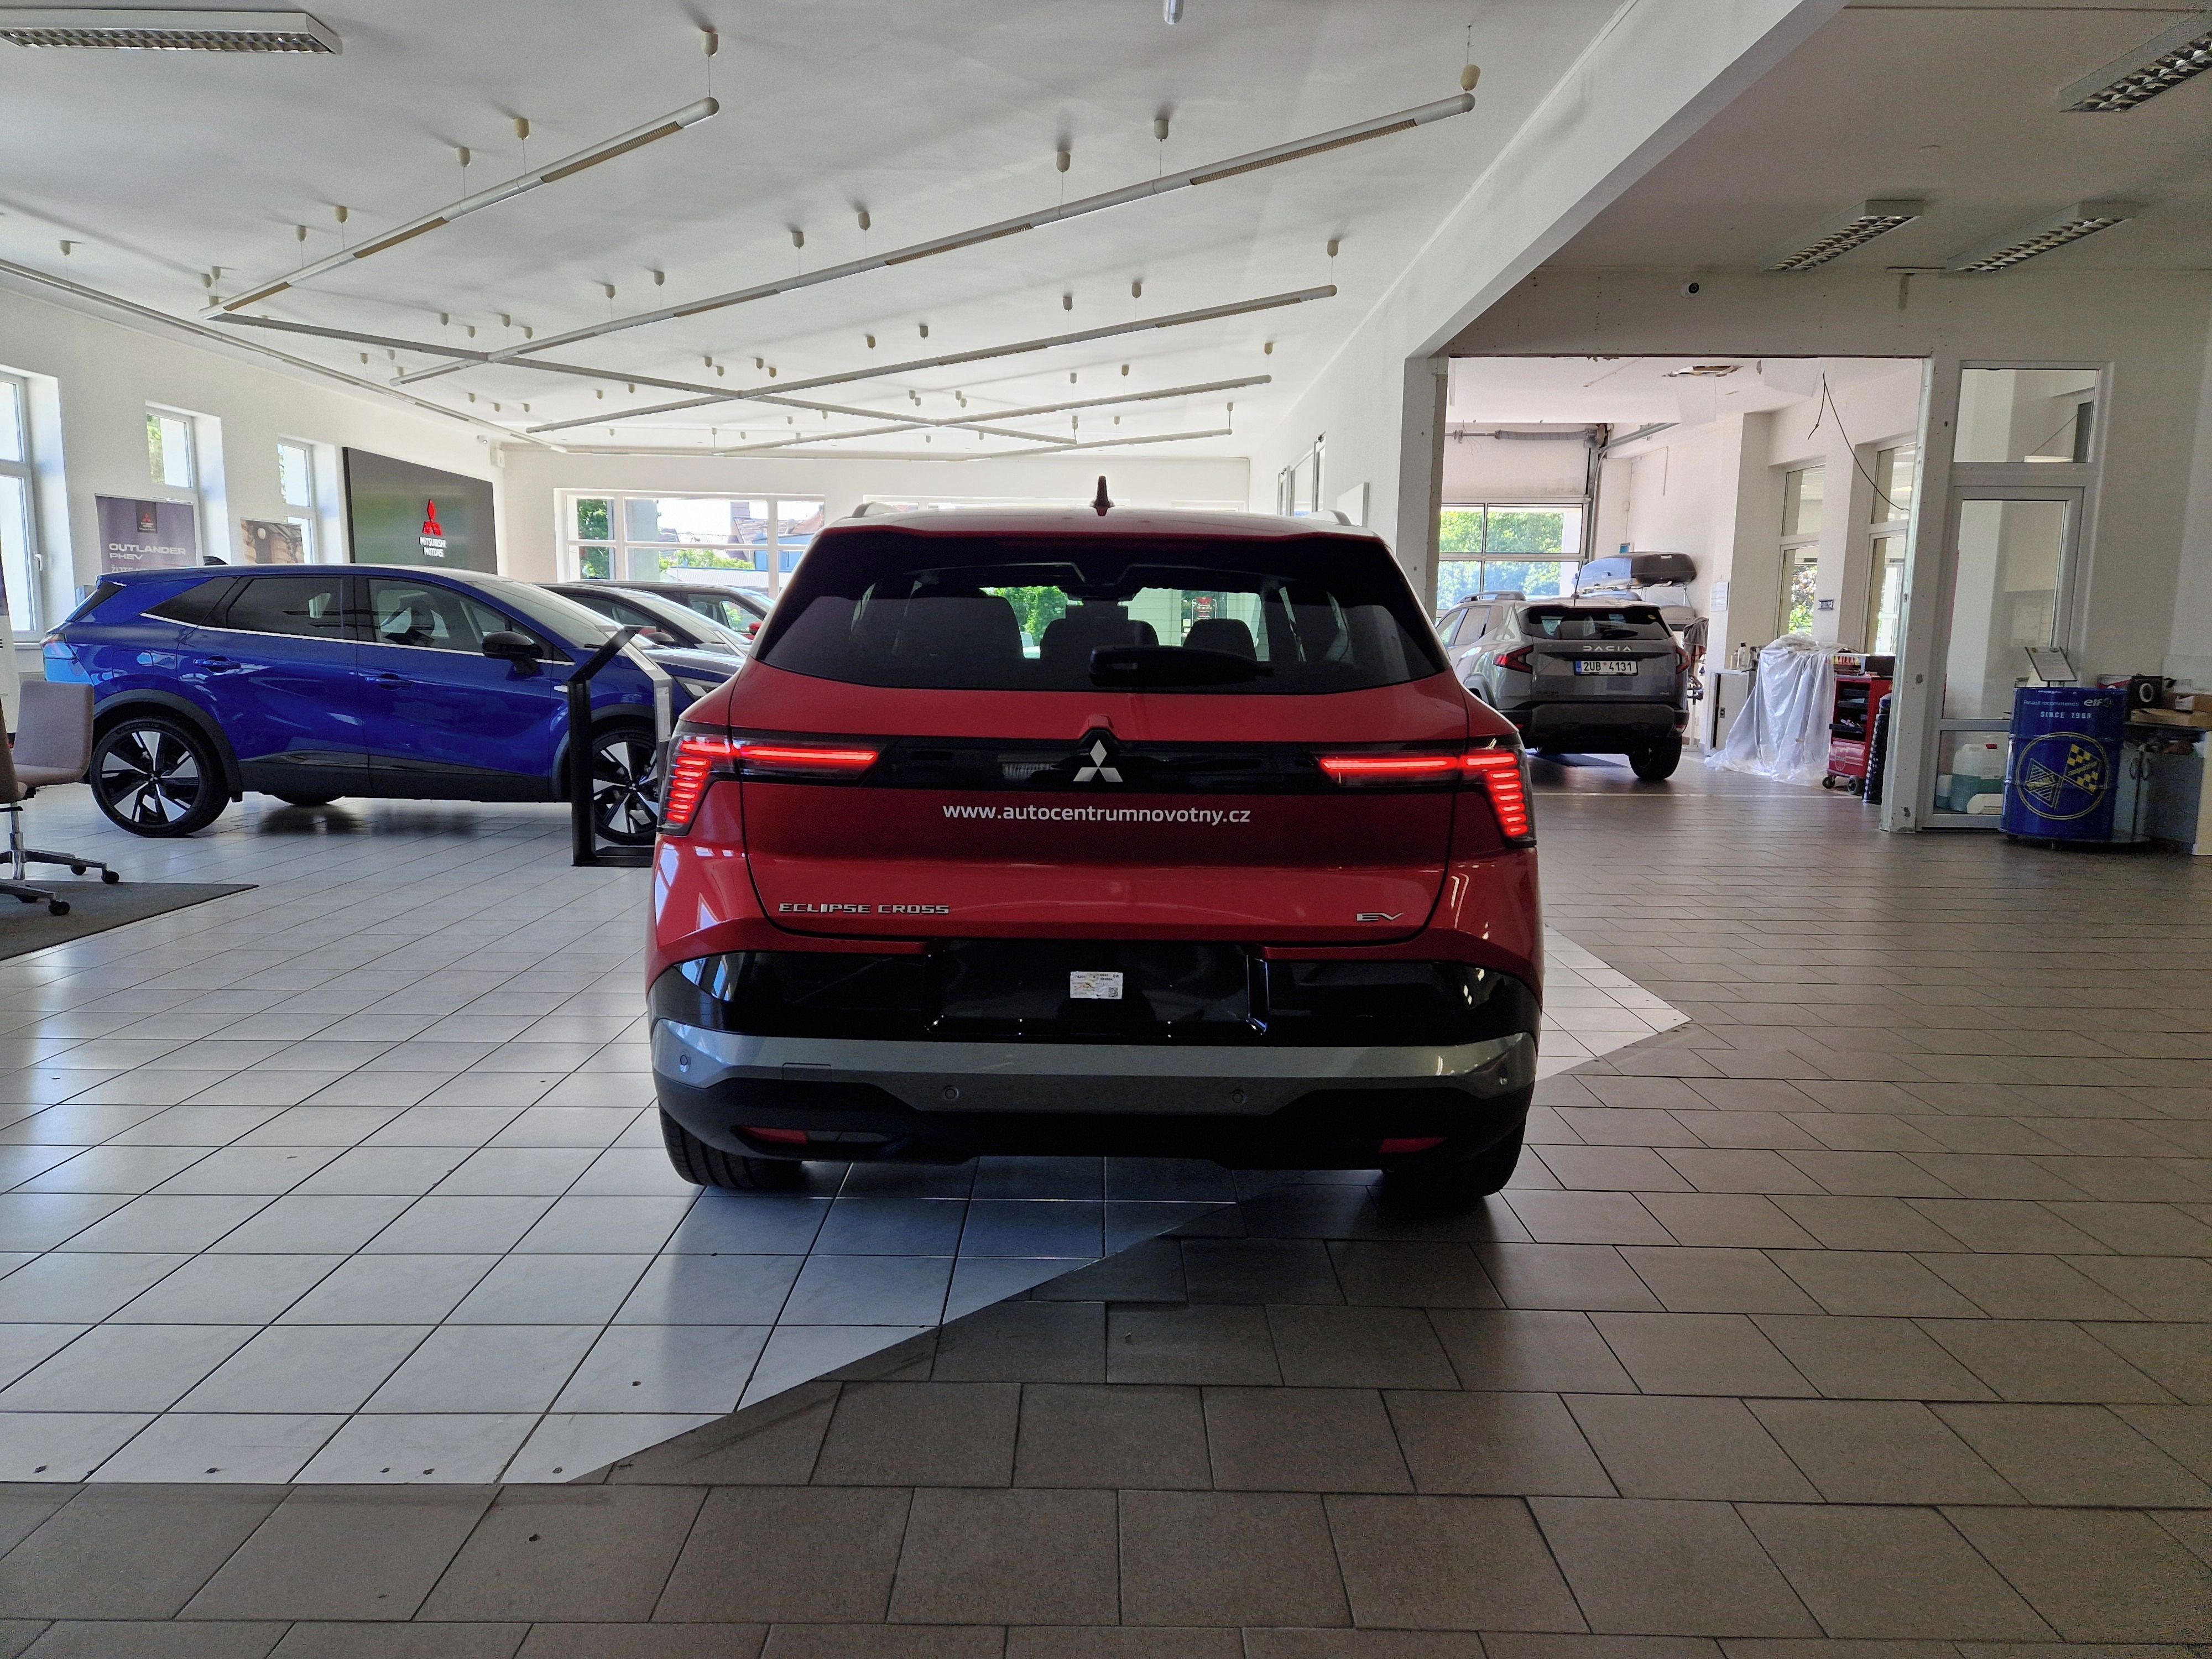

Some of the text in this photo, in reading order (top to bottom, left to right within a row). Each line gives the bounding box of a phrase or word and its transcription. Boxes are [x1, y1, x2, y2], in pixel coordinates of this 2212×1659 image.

[420, 536, 446, 548] MITSUBISHI
[109, 543, 186, 555] OUTLANDER
[424, 547, 444, 557] MOTORS
[1584, 661, 1632, 671] 2UB 4131
[942, 805, 1251, 826] www.autocentrumnovotny.cz
[779, 902, 950, 914] ECLIPSE CROSS
[1357, 912, 1405, 921] EV
